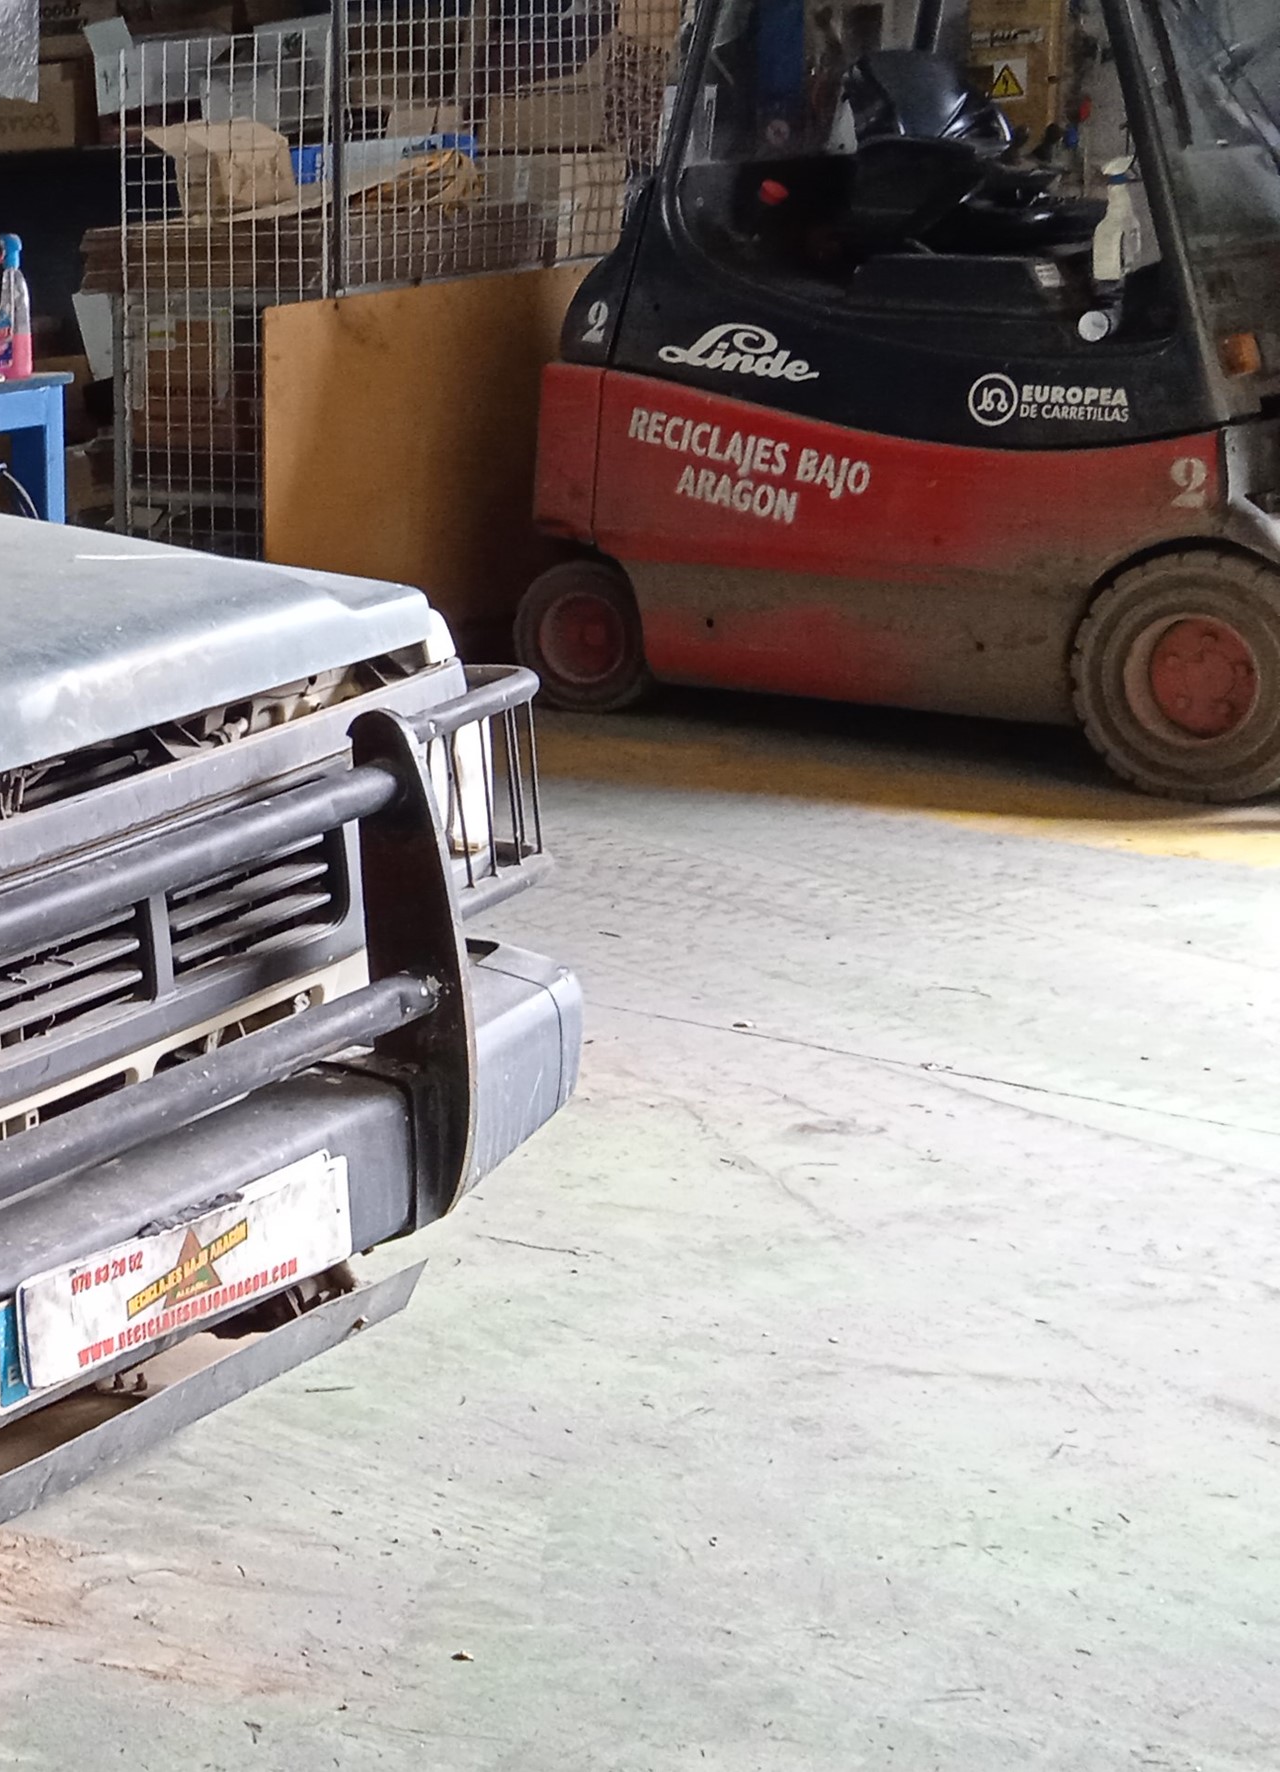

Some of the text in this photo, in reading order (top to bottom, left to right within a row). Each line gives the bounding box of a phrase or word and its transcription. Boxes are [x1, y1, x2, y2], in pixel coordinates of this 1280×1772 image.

[581, 300, 609, 344] 2
[658, 323, 820, 381] Linde
[1019, 404, 1130, 422] DE CARRETILLAS
[1021, 384, 1129, 407] EUROPEA
[628, 407, 871, 499] RECICLAJES BAJO
[675, 465, 798, 523] ARAGON
[1170, 457, 1207, 508] 2
[111, 1257, 126, 1281] 20
[129, 1250, 144, 1273] 52
[128, 1265, 184, 1318] RECICLAJES
[7, 1364, 20, 1389] E
